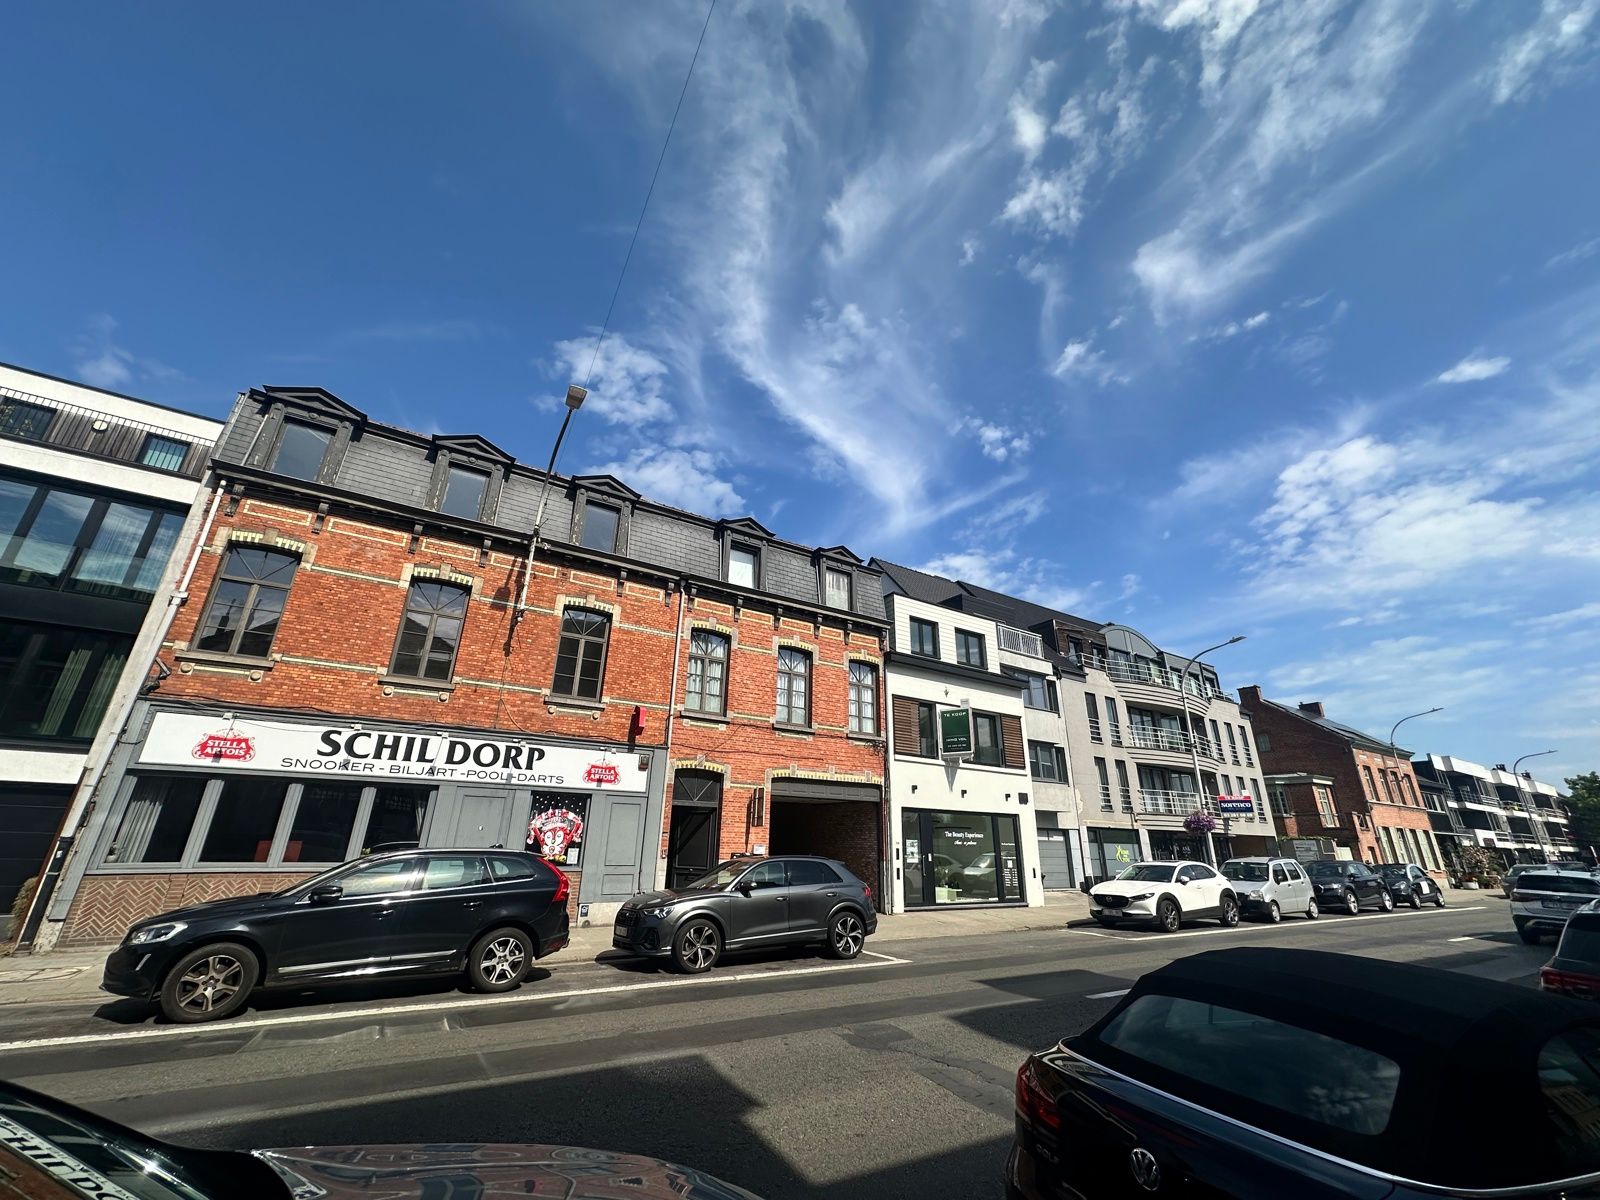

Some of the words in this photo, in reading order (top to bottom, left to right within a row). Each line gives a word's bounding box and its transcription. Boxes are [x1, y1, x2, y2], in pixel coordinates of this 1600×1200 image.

[206, 739, 247, 750] STELLA
[204, 746, 245, 756] ARTOIS
[281, 757, 375, 773] SNOOKER
[389, 764, 458, 777] BILJART
[591, 767, 615, 775] STELLA
